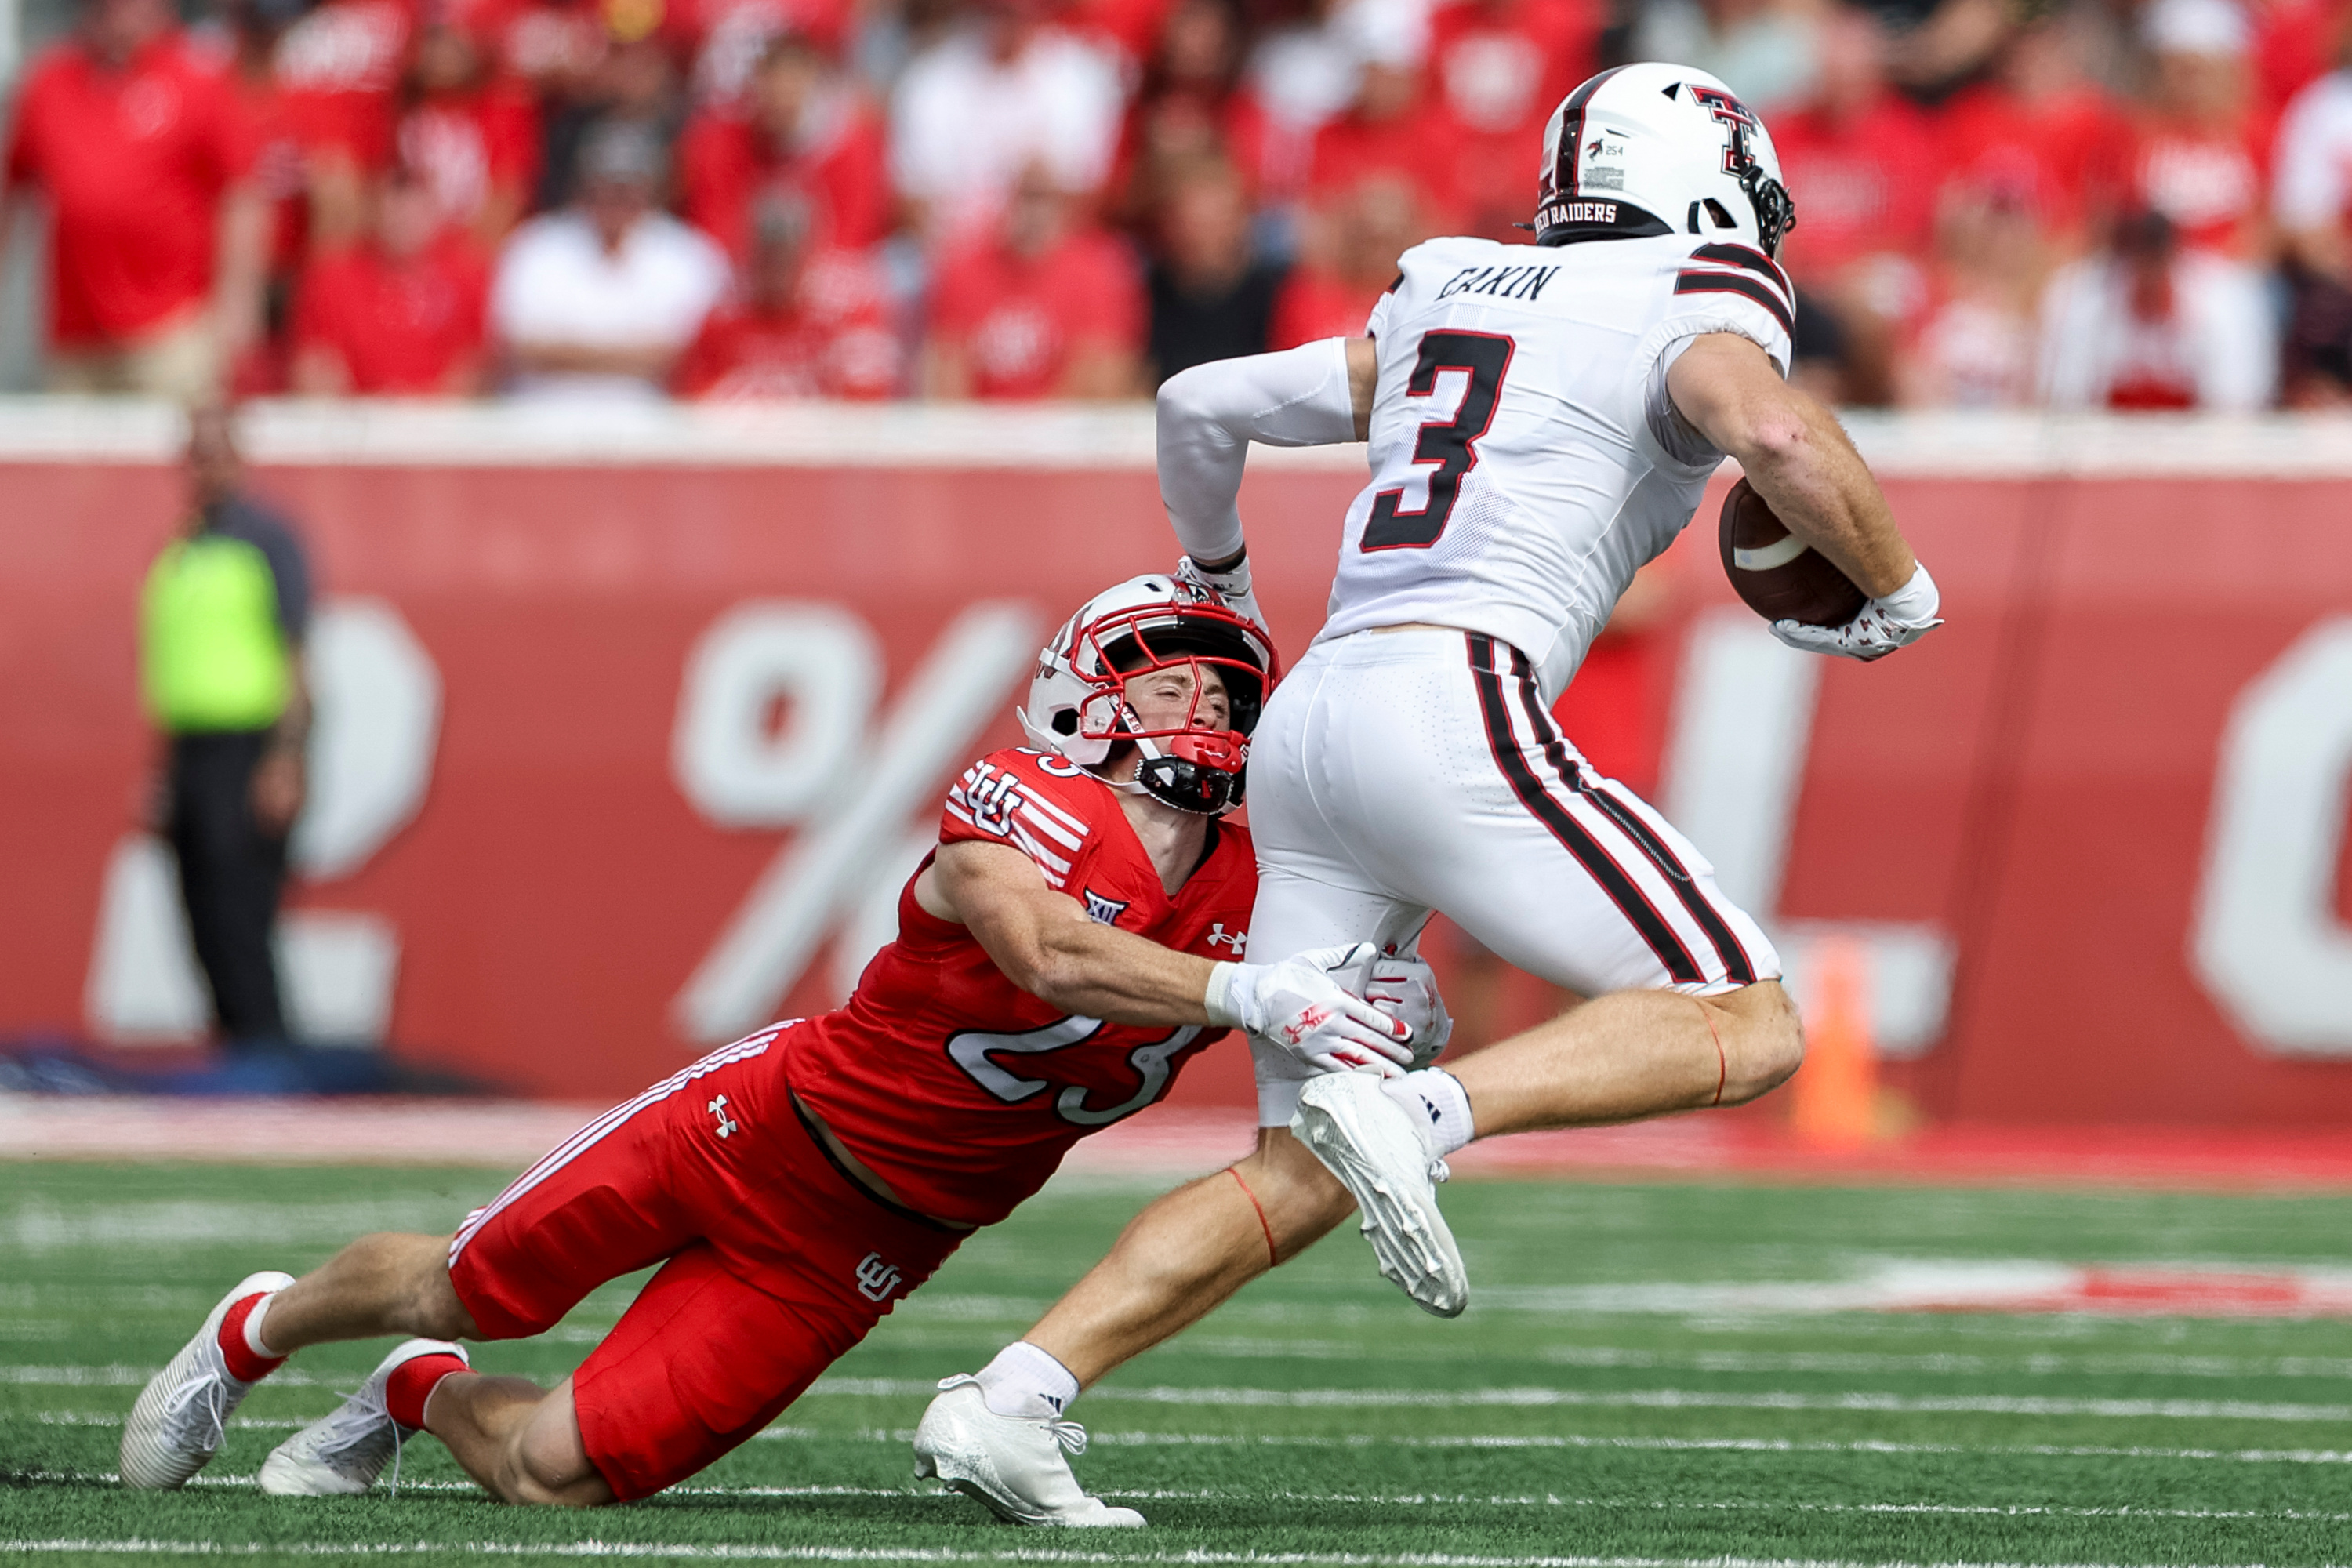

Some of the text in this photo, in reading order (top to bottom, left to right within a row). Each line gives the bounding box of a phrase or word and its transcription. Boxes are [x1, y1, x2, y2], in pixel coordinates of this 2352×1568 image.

[1605, 145, 1624, 156] 254
[1550, 202, 1617, 223] RAIDERS
[1434, 266, 1563, 301] EAKIN
[1359, 328, 1516, 554] 3
[946, 1014, 1204, 1126] 23
